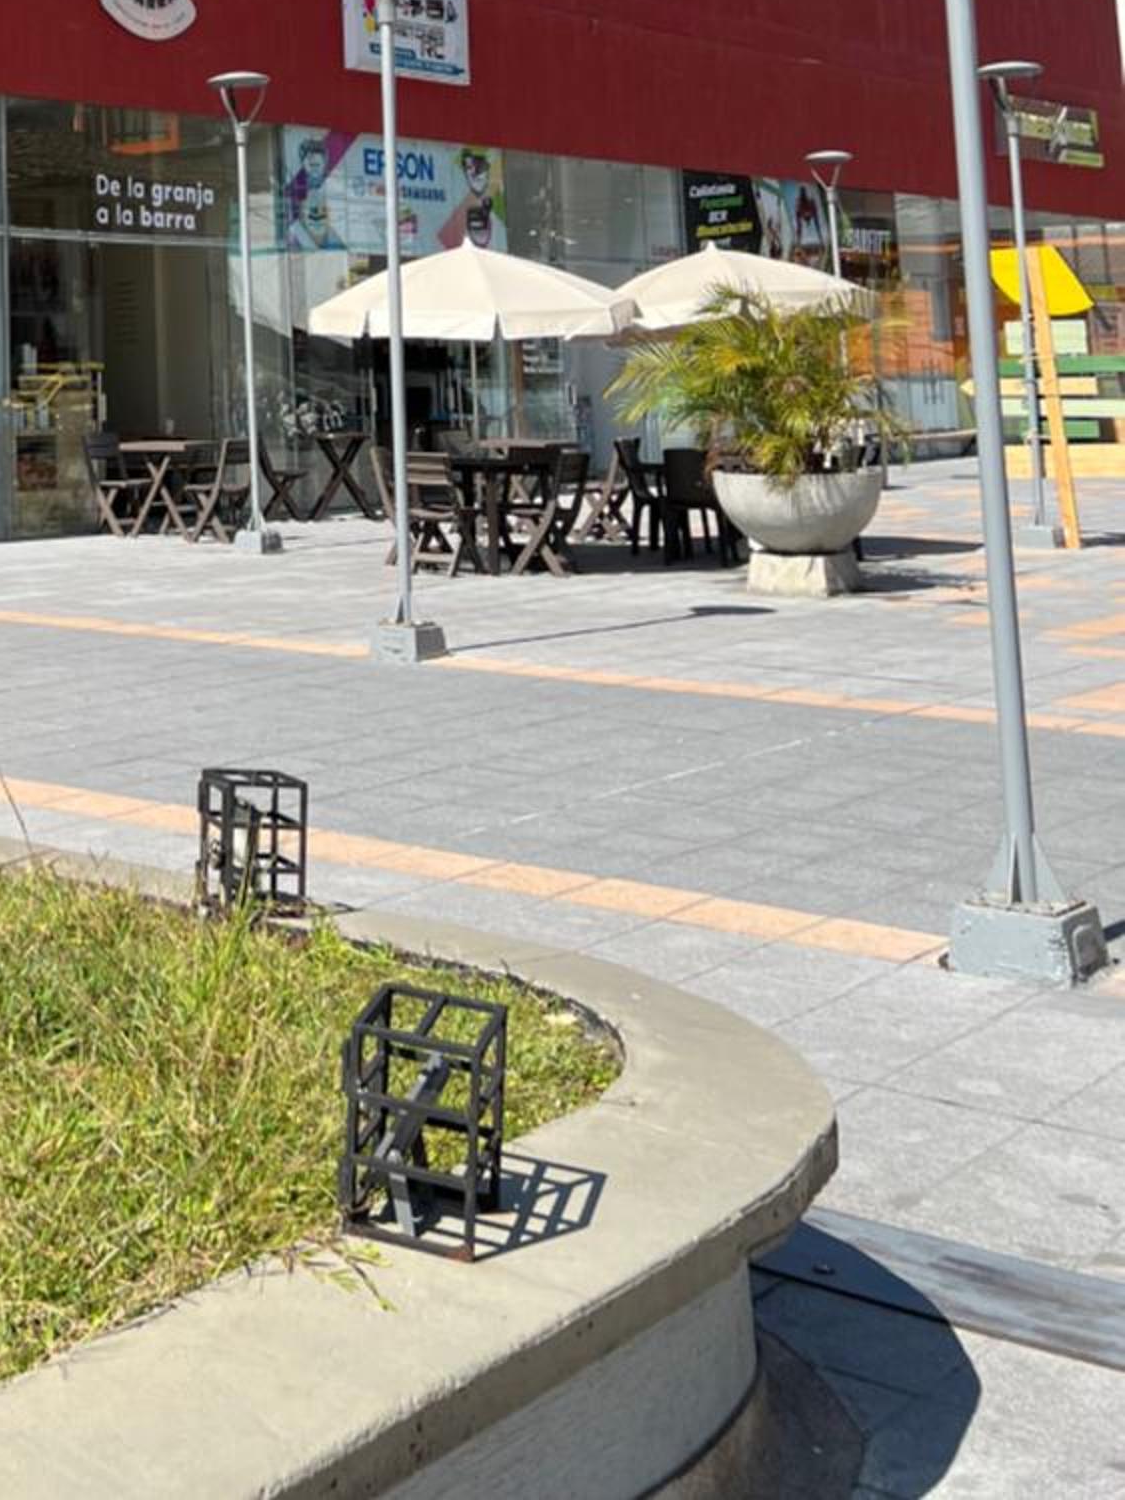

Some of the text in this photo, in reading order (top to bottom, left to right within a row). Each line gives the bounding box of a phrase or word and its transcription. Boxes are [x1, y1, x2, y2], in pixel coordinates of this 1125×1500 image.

[96, 173, 214, 211] De la granja
[96, 203, 195, 230] a la barra
